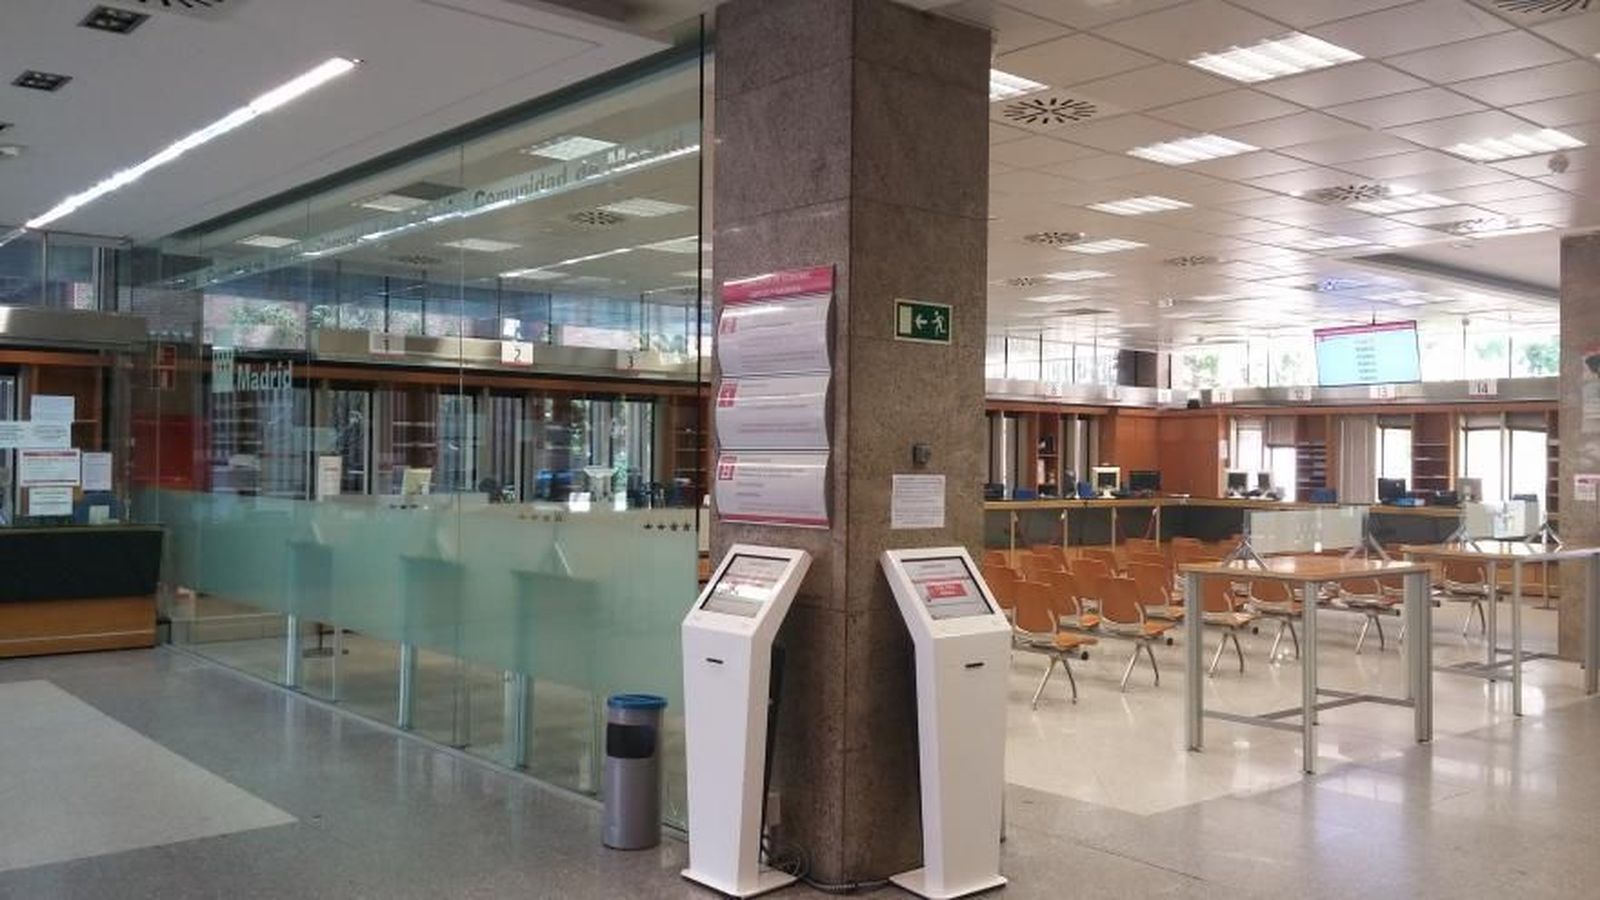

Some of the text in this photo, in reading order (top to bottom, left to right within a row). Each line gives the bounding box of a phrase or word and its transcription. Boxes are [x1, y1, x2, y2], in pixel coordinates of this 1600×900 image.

[474, 166, 568, 205] Comunidad
[513, 348, 522, 361] 2
[237, 360, 293, 392] Madrid
[1477, 383, 1489, 394] 14
